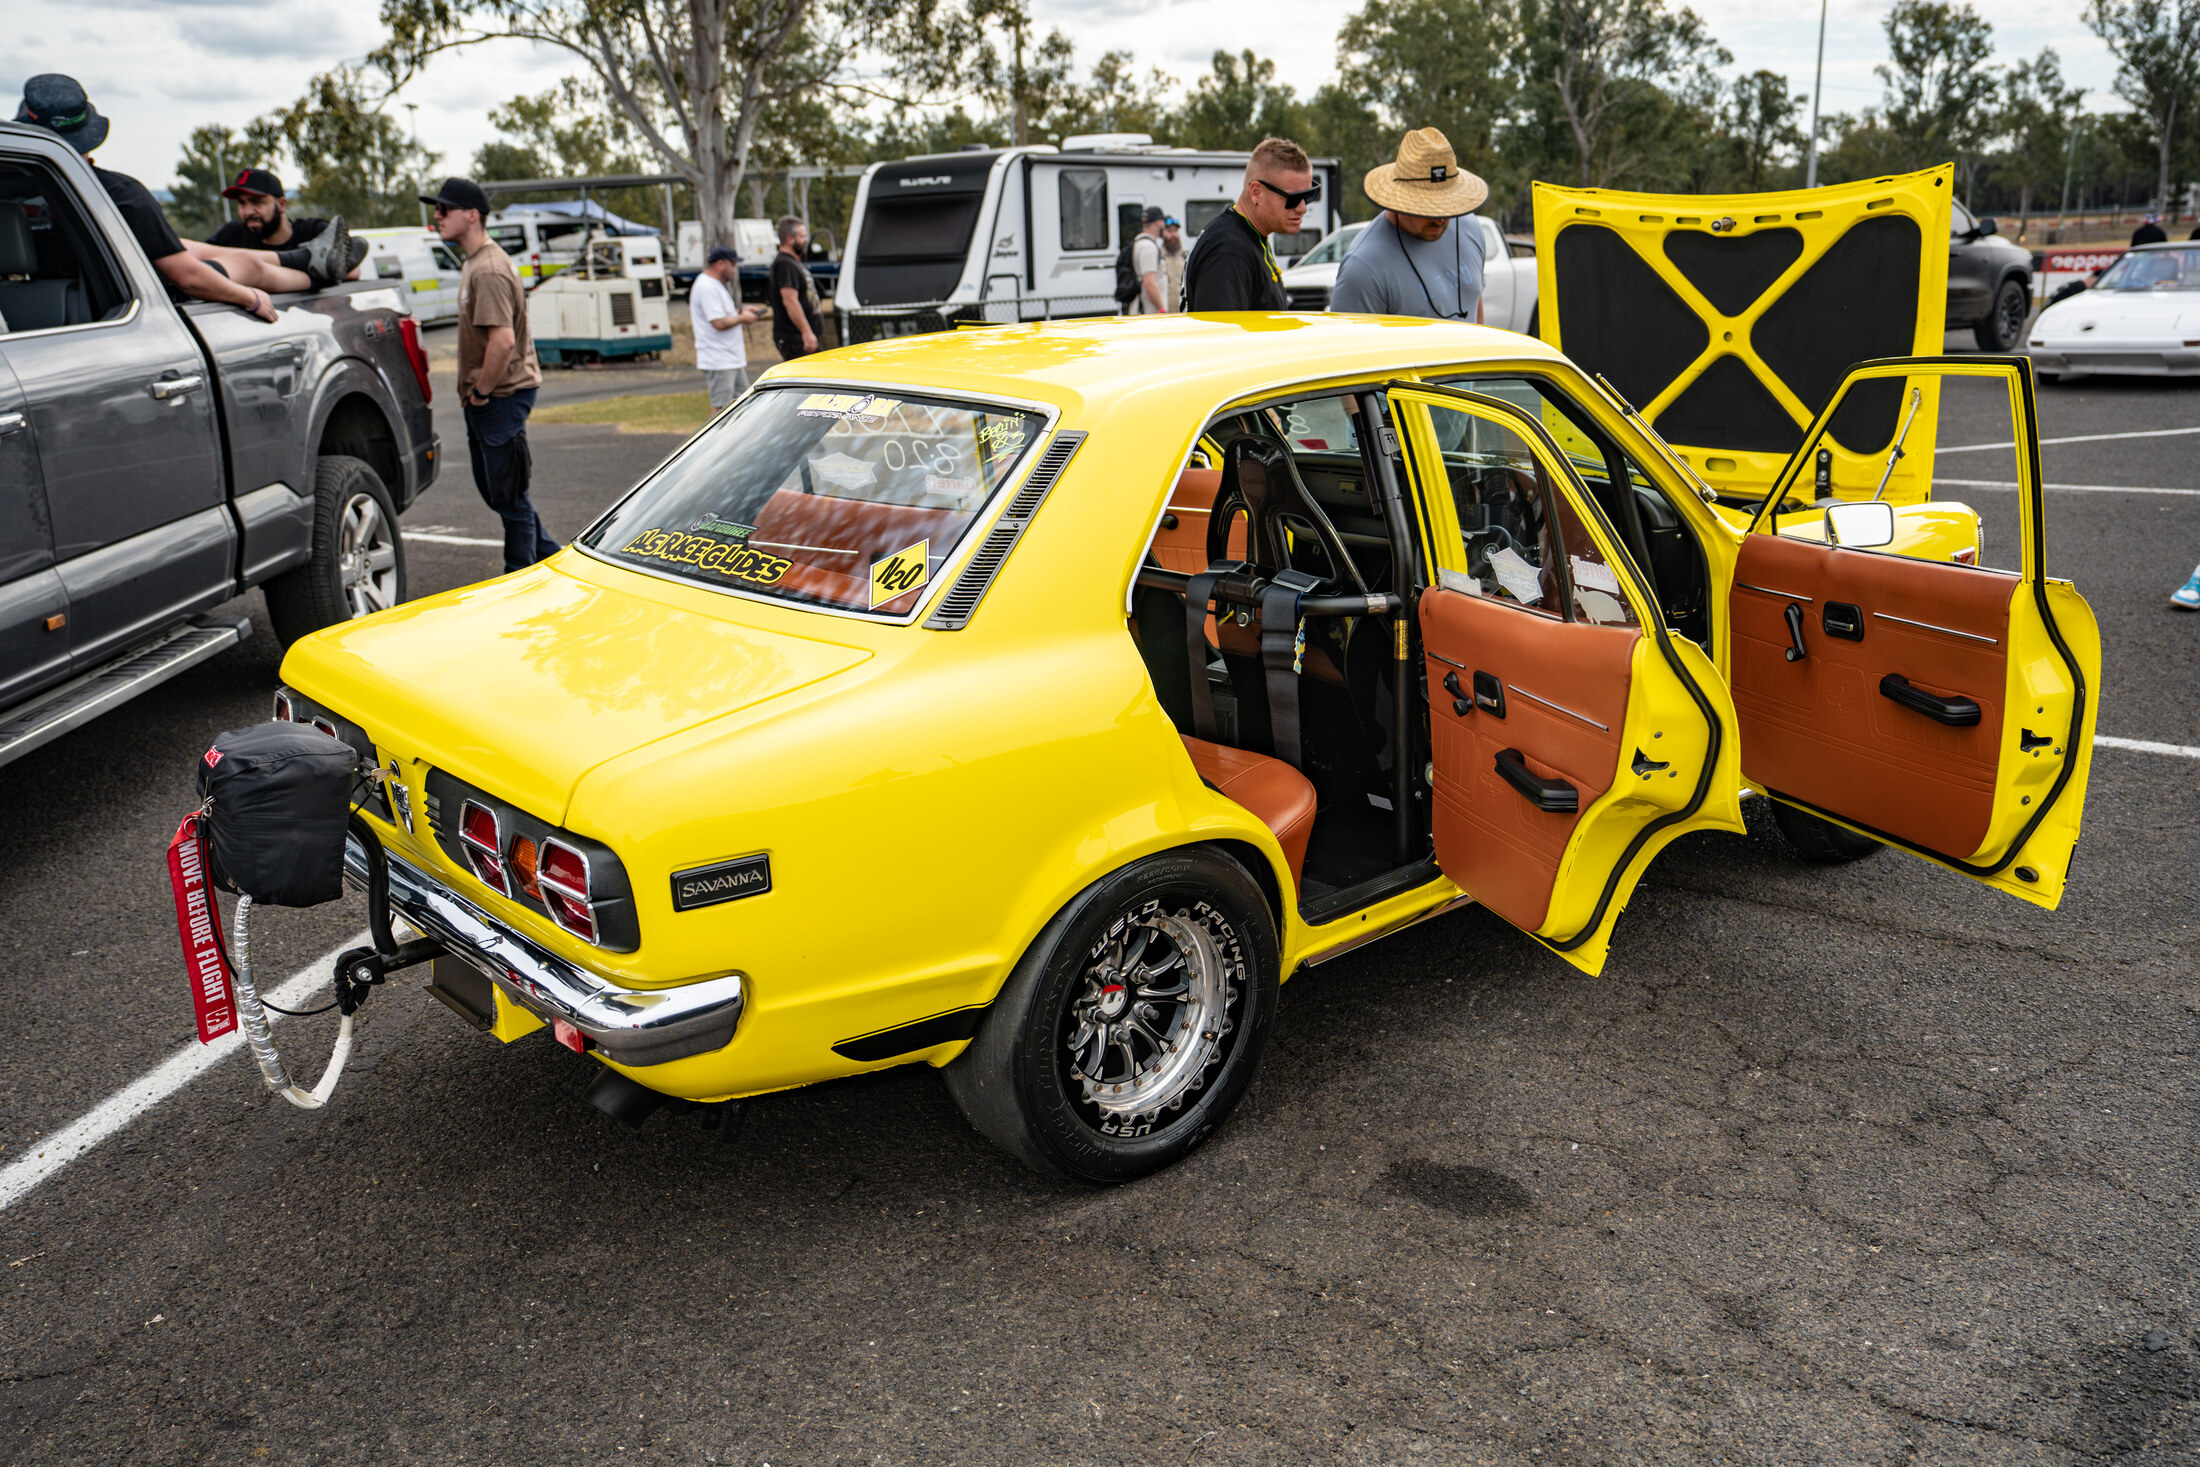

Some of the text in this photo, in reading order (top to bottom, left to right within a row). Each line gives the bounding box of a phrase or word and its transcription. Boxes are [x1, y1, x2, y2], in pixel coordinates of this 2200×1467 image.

[682, 868, 765, 898] SAVANNA
[178, 832, 226, 1004] MOVE BEFORE FLIGHT
[1091, 899, 1160, 959] WELD
[1193, 900, 1247, 981] RACING
[1100, 1121, 1152, 1138] USA
